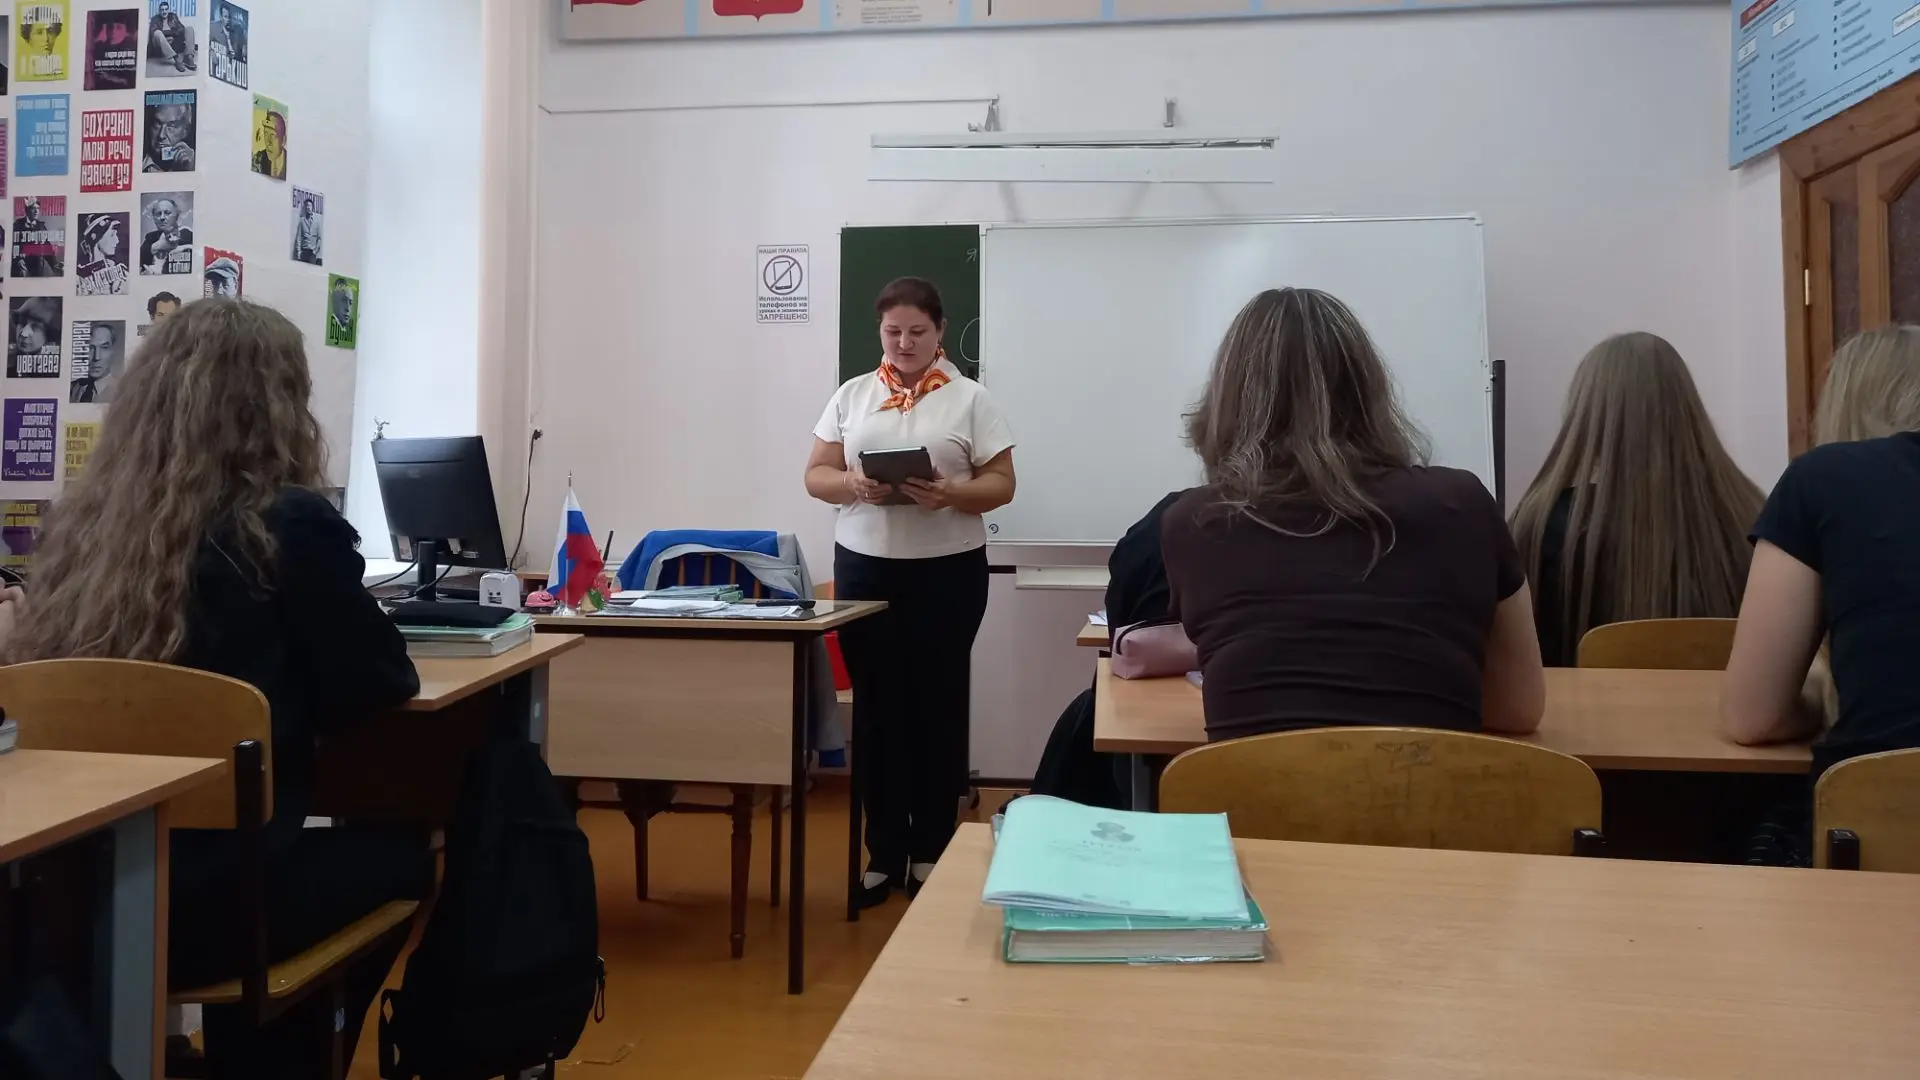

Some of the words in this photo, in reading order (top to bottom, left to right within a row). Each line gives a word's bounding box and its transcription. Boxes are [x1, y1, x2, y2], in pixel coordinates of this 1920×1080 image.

[83, 112, 132, 137] сохрани
[83, 141, 105, 161] мою
[108, 140, 131, 160] речь
[81, 163, 130, 189] навсегда
[71, 320, 91, 379] пастернак
[16, 354, 59, 377] цветаева
